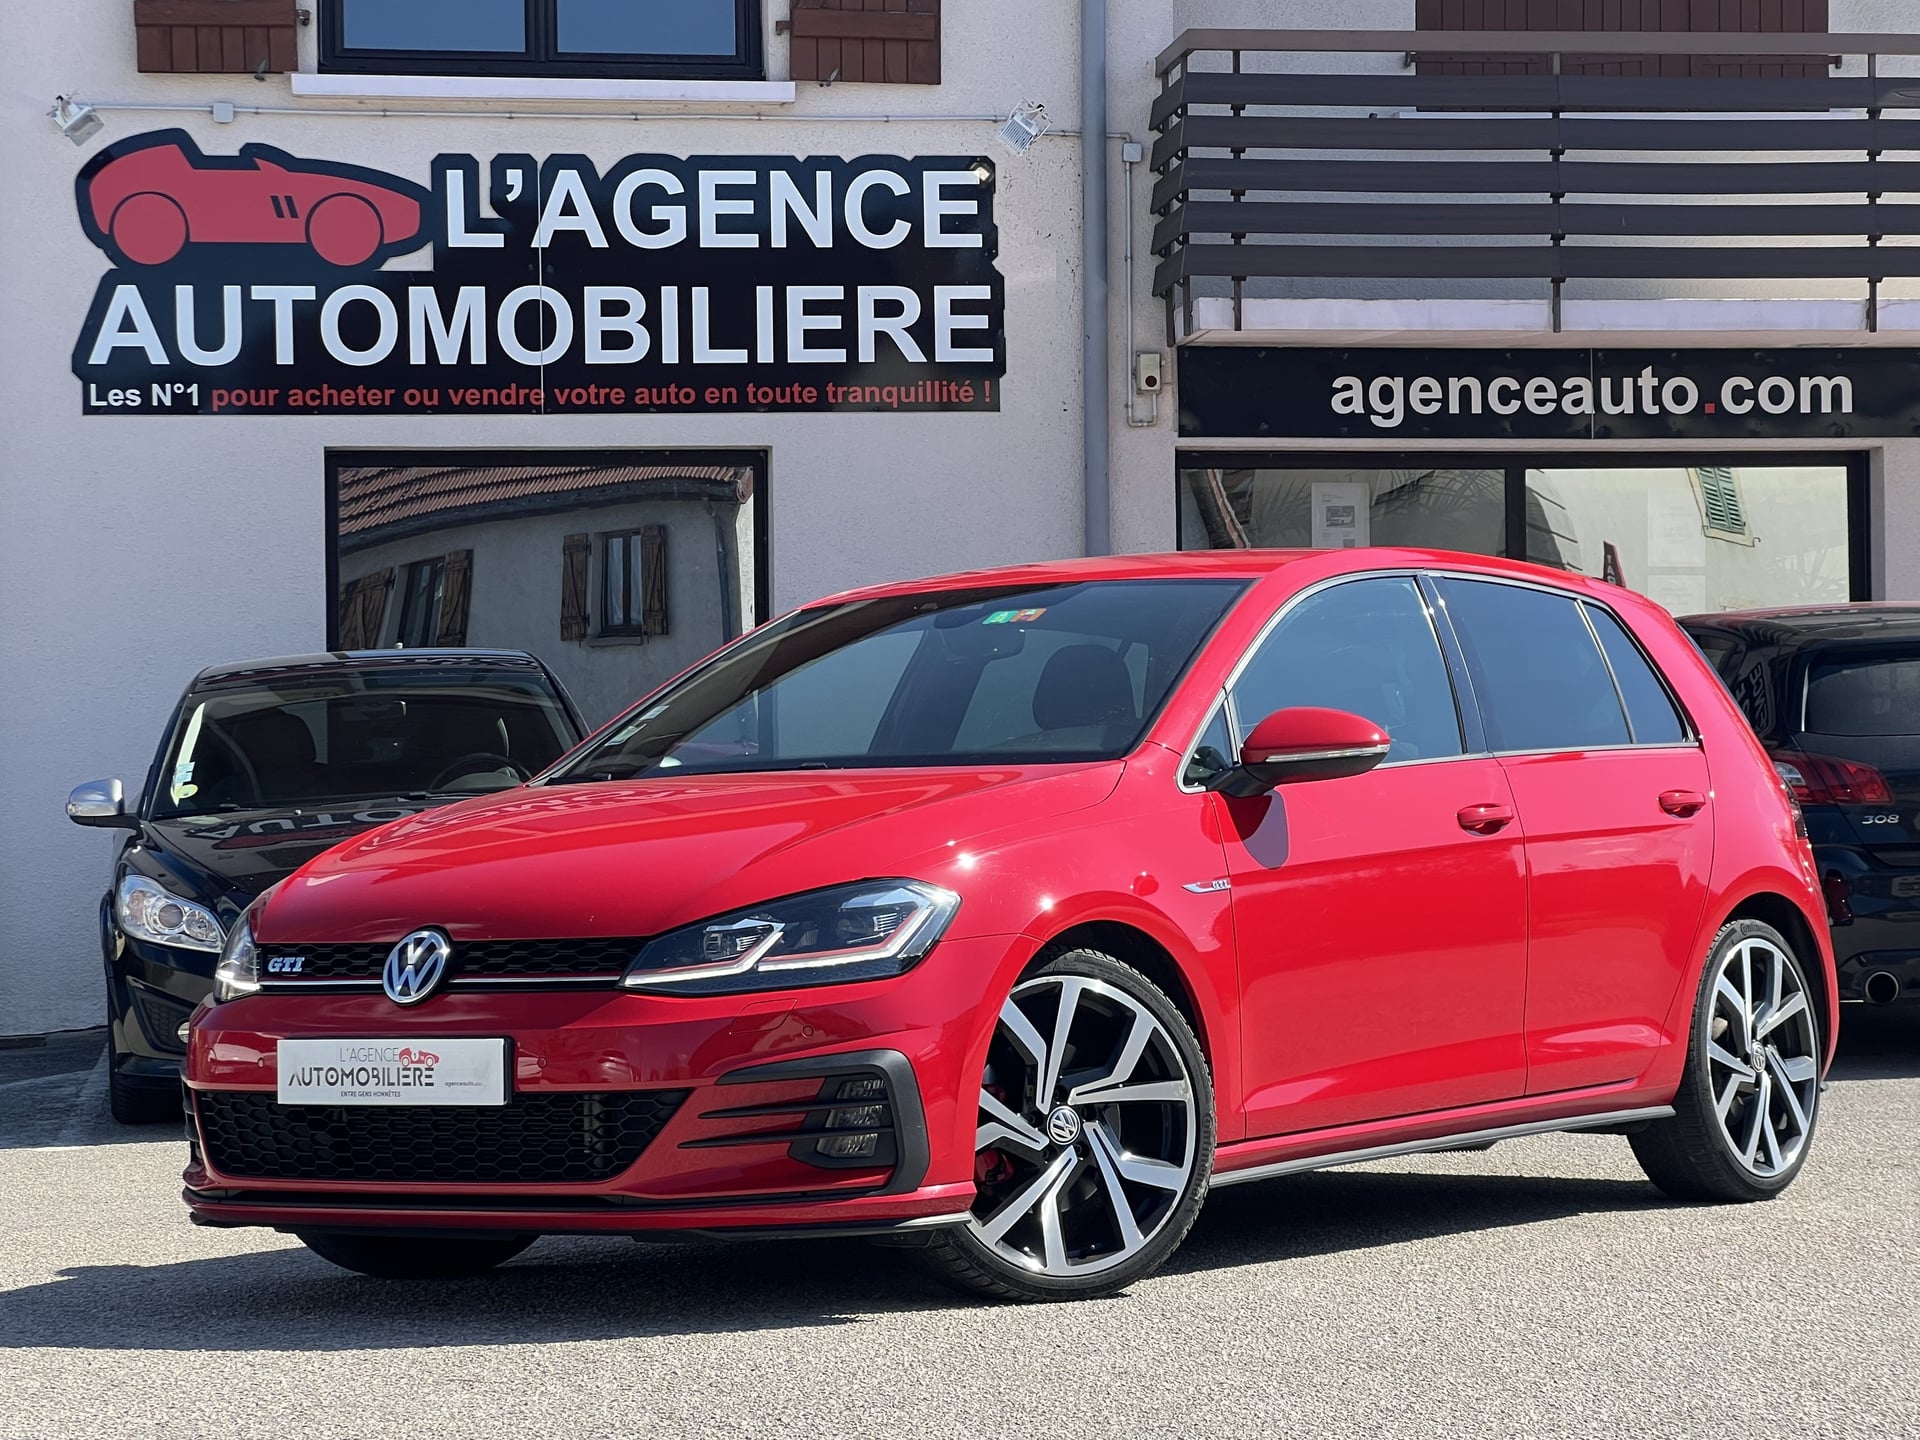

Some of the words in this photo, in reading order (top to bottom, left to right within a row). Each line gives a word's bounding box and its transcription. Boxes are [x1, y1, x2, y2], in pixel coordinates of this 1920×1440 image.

[446, 169, 982, 249] L'AGENCE
[88, 284, 994, 367] AUTOMOBILIERE
[90, 383, 142, 407] Les
[151, 383, 199, 407] N°1
[212, 388, 279, 411] pour
[288, 383, 395, 406] acheter
[403, 388, 439, 406] ou
[448, 382, 546, 406] vendre
[554, 383, 626, 405] votre
[634, 382, 696, 405] auto
[704, 386, 738, 404] en
[746, 382, 818, 404] toute
[826, 380, 975, 409] tranquillité
[1331, 365, 1853, 428] agenceauto.com
[1861, 814, 1900, 824] 308
[268, 957, 305, 972] GTI
[340, 1047, 400, 1063] L'AGENCE
